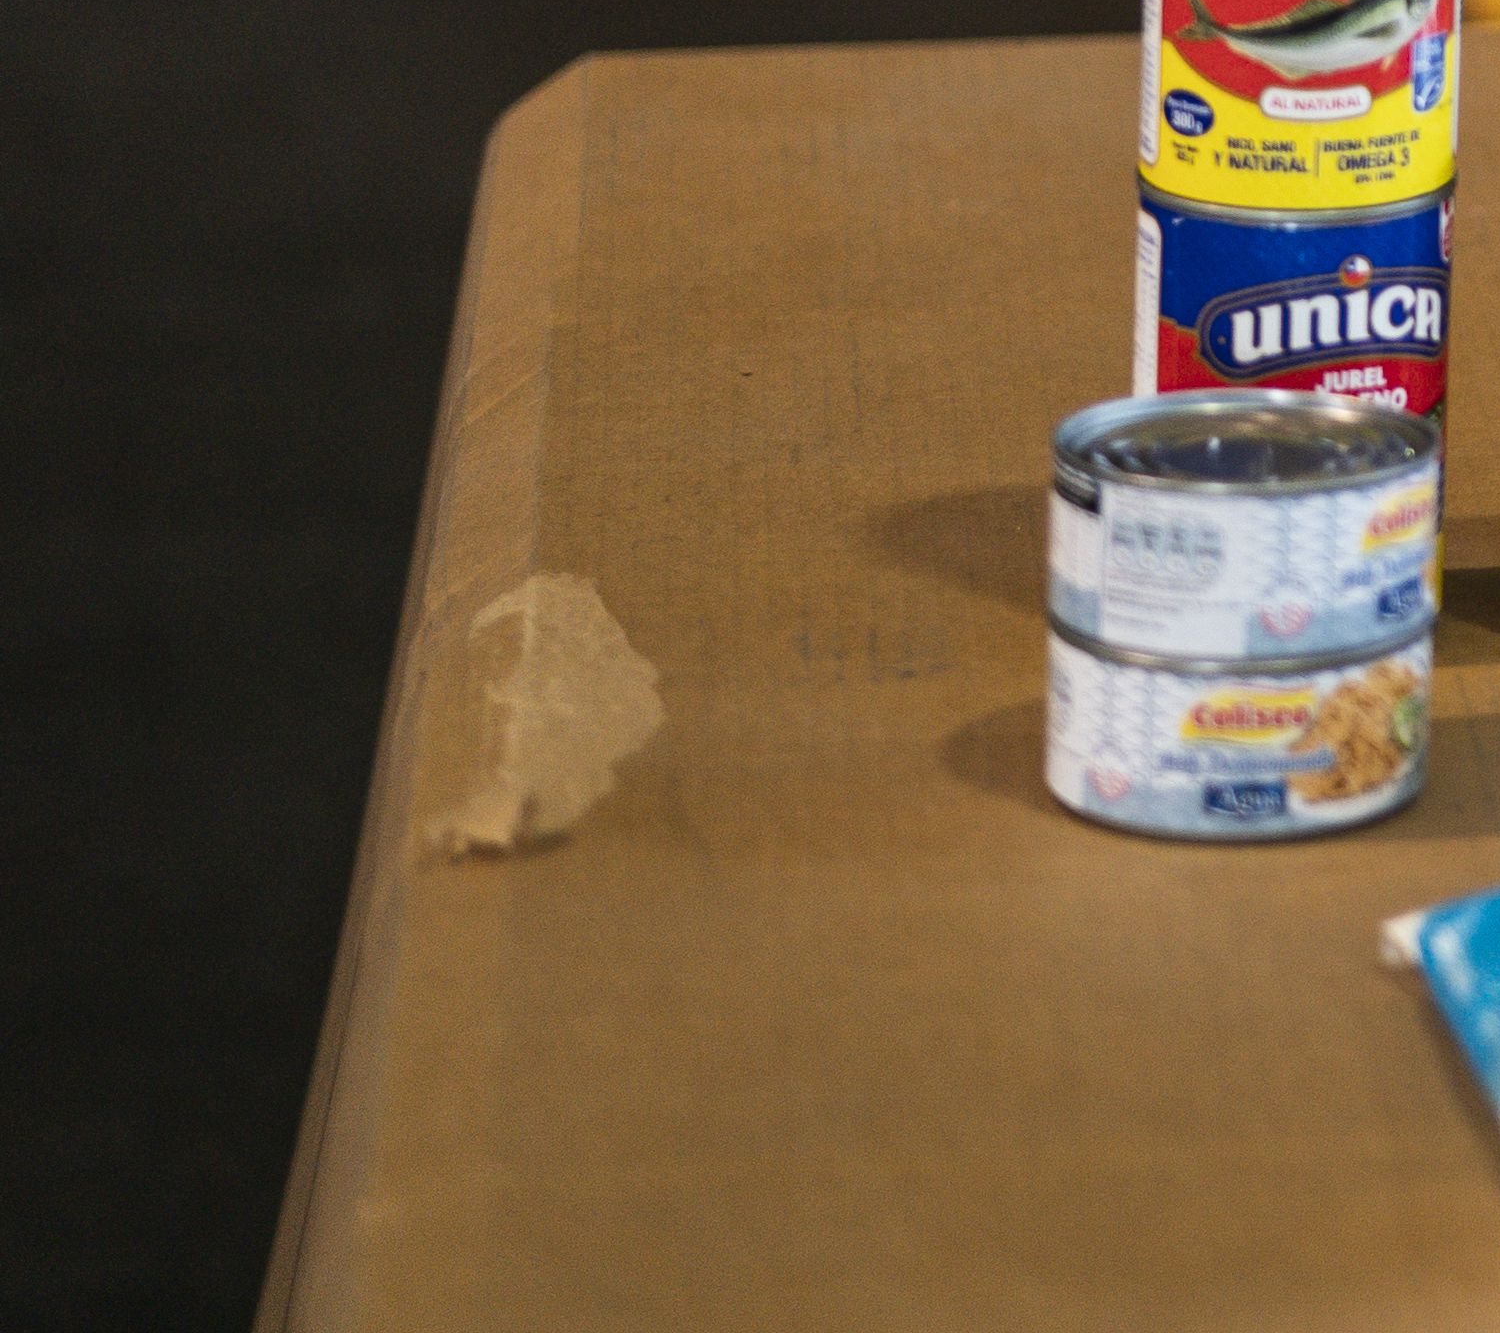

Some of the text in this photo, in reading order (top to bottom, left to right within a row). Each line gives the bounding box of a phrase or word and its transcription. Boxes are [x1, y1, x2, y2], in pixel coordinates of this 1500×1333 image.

[1229, 153, 1309, 174] NATURAL
[1338, 150, 1395, 172] OMEGA
[1315, 365, 1388, 393] JUREL
